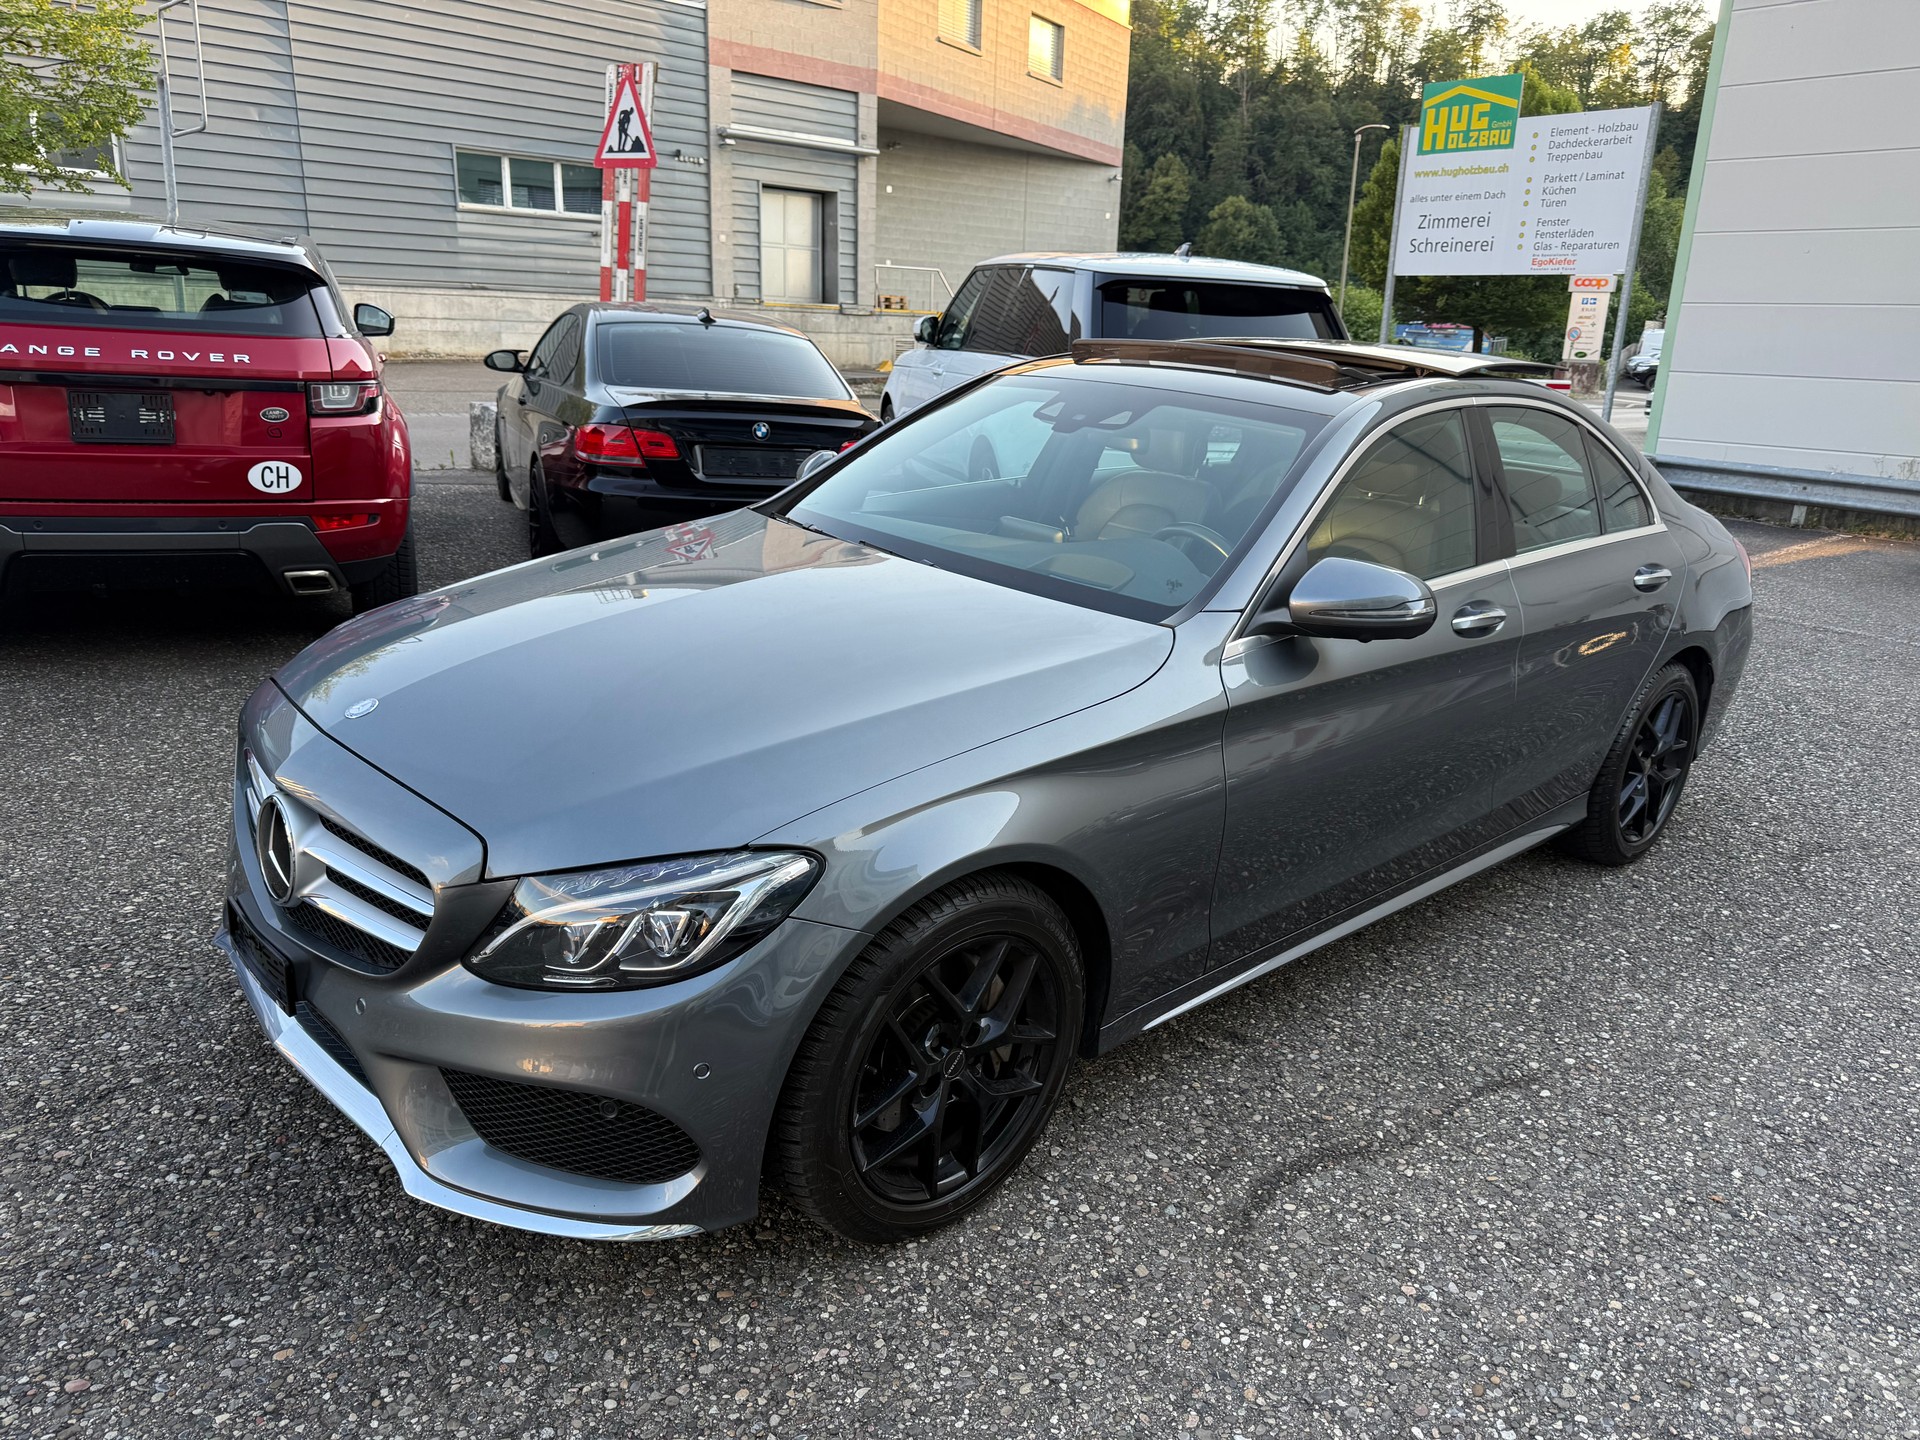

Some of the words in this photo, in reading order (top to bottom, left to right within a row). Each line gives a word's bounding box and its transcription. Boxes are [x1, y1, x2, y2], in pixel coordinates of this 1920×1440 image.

[1422, 103, 1491, 151] HUG
[1491, 120, 1513, 129] GmbH
[1550, 126, 1589, 137] Element
[1597, 122, 1639, 134] Holzbau
[1548, 134, 1633, 150] Dachdeckerarbeit
[1547, 150, 1603, 163] Treppenbau
[1414, 163, 1509, 179] www.hugholzbau.ch
[1543, 172, 1577, 183] Parkett
[1585, 170, 1625, 181] Laminat
[1409, 194, 1428, 203] alles
[1430, 194, 1453, 202] unter
[1454, 192, 1482, 201] einem
[1483, 190, 1506, 200] Dach
[1541, 185, 1577, 196] Küchen
[1540, 199, 1567, 208] Türen
[1417, 211, 1491, 229] Zimmerei
[1536, 218, 1571, 227] Fenster
[1534, 229, 1594, 239] Fensterläden
[1409, 236, 1495, 253] Schreinerei
[1533, 242, 1553, 251] Glas
[1560, 241, 1620, 252] Reparaturen
[1531, 257, 1577, 267] EgoKiefer
[1574, 278, 1609, 289] coop
[0, 343, 101, 357] ANGE
[131, 349, 251, 364] ROVER
[261, 465, 290, 489] CH
